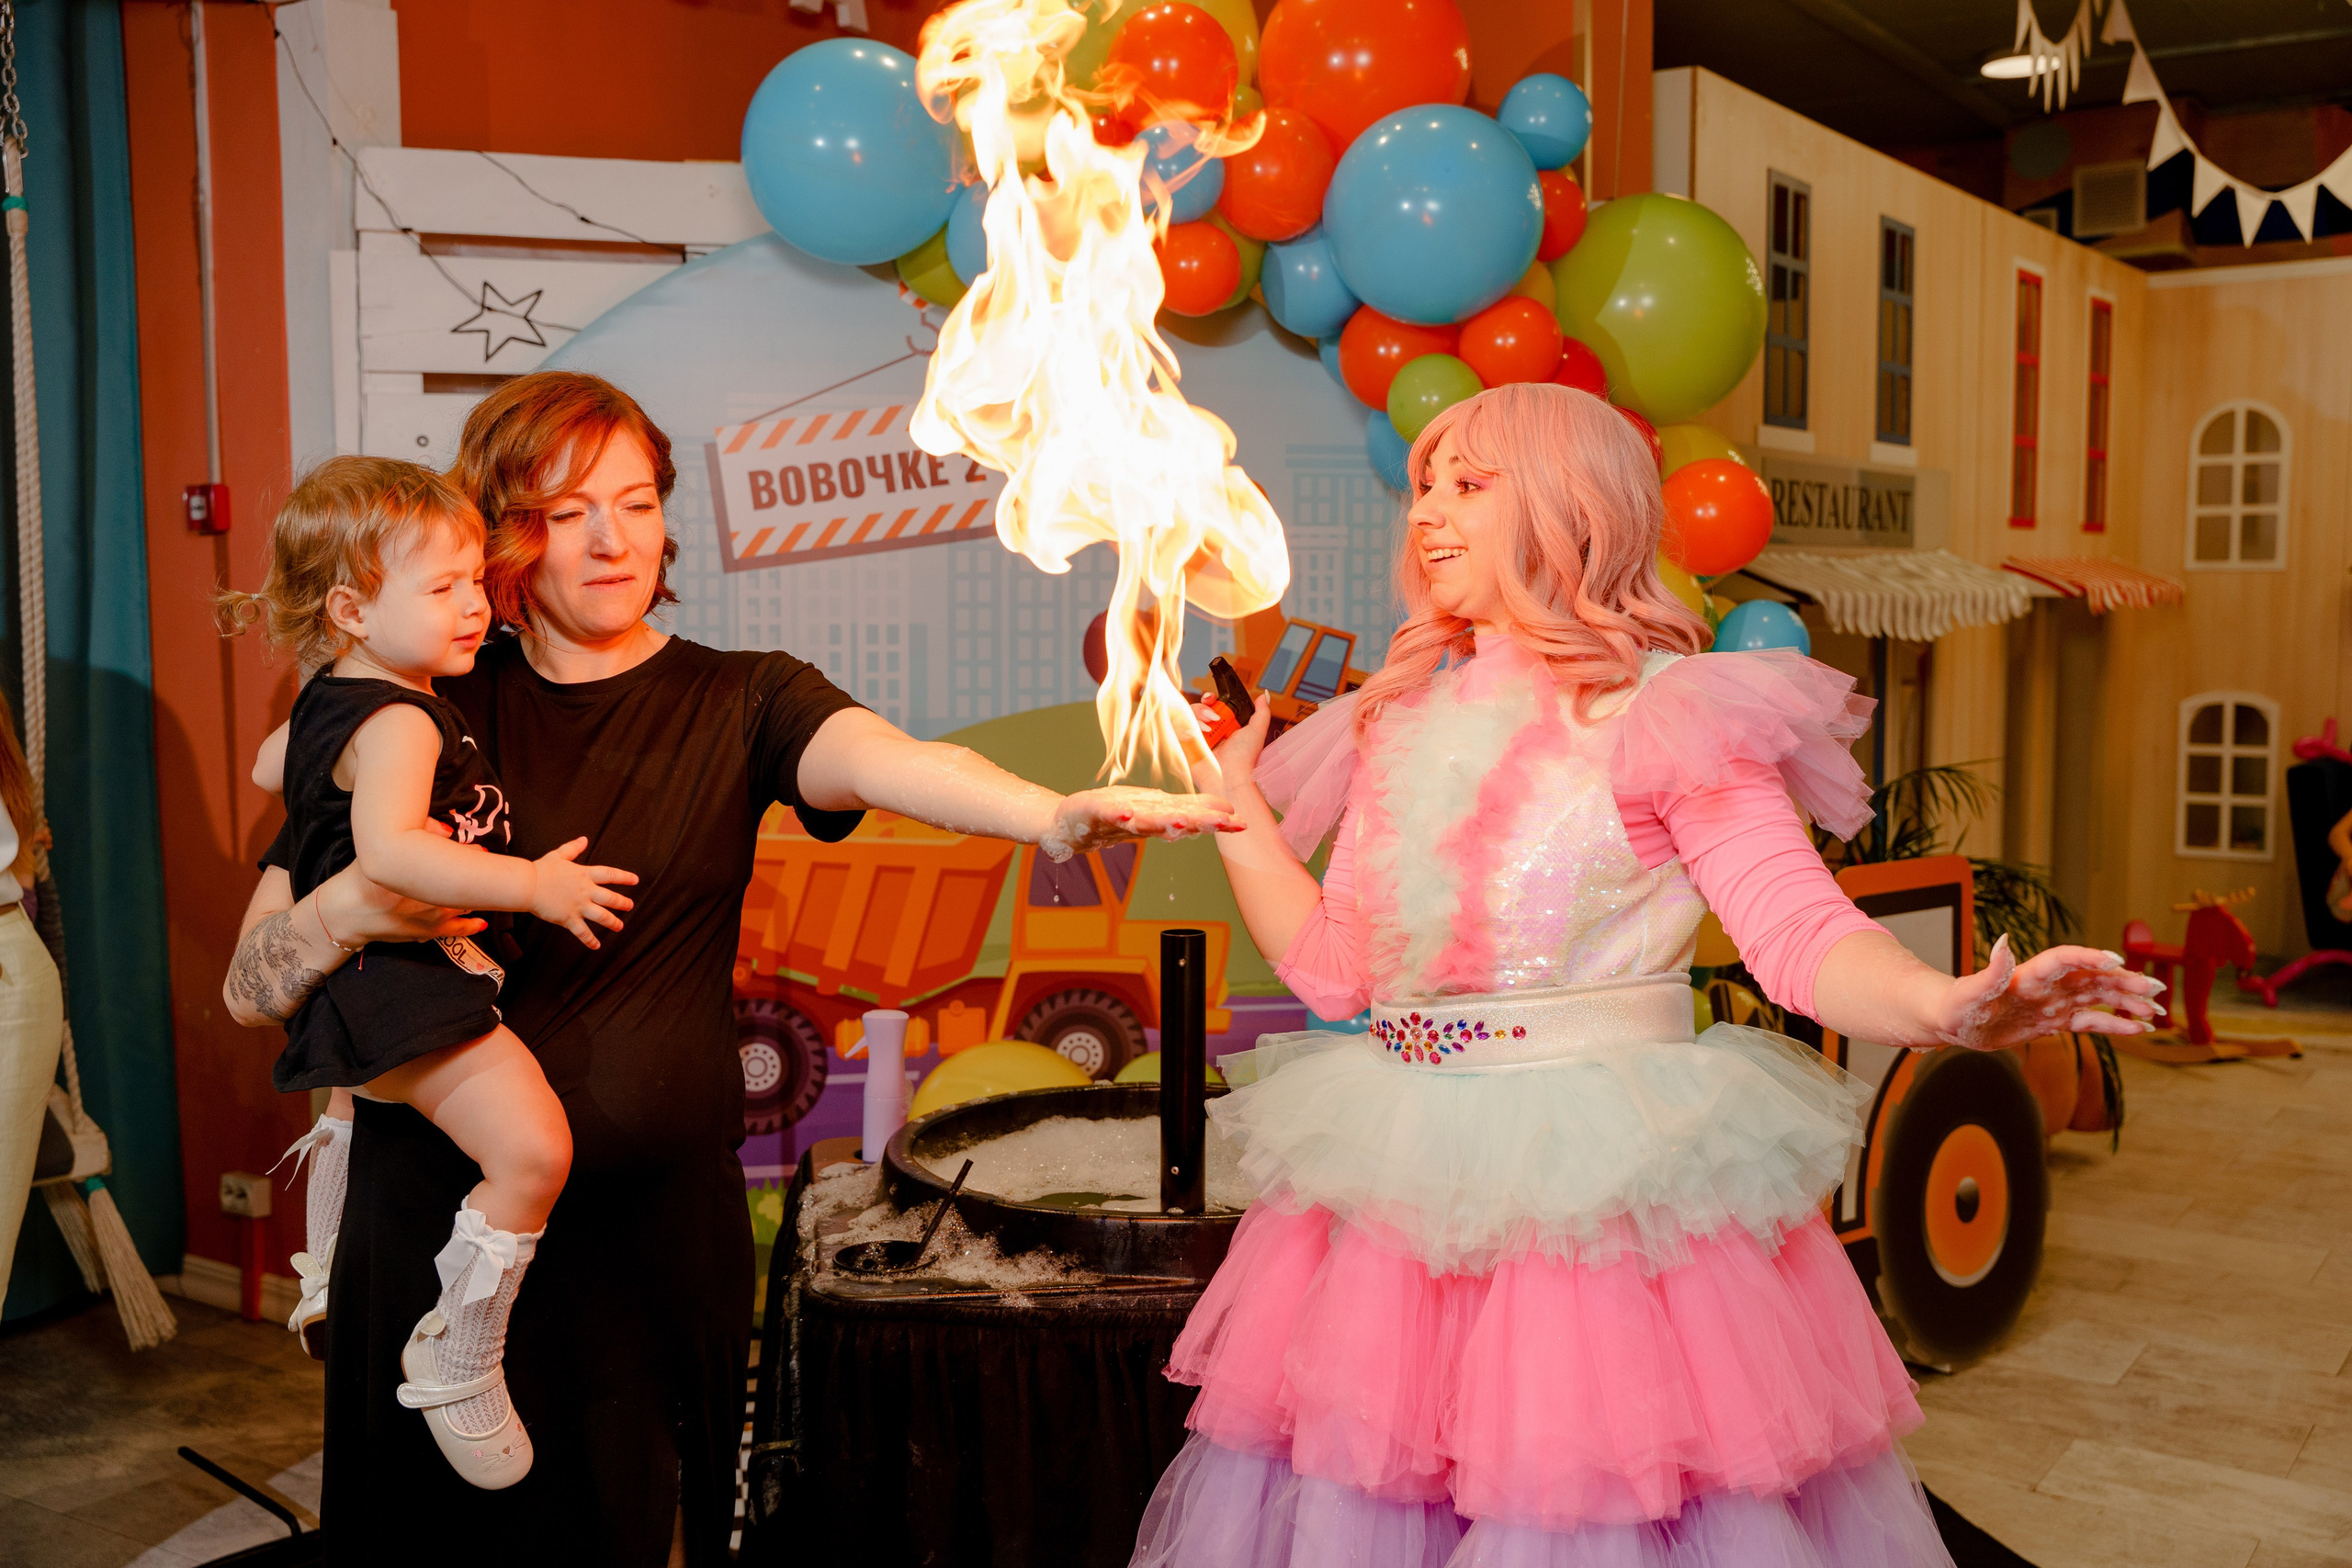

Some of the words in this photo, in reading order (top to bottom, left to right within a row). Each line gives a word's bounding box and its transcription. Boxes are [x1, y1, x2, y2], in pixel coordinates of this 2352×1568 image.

[748, 449, 949, 511] ВОВОЧКЕ
[1770, 477, 1913, 533] RESTAURANT
[439, 936, 467, 965] OOL
